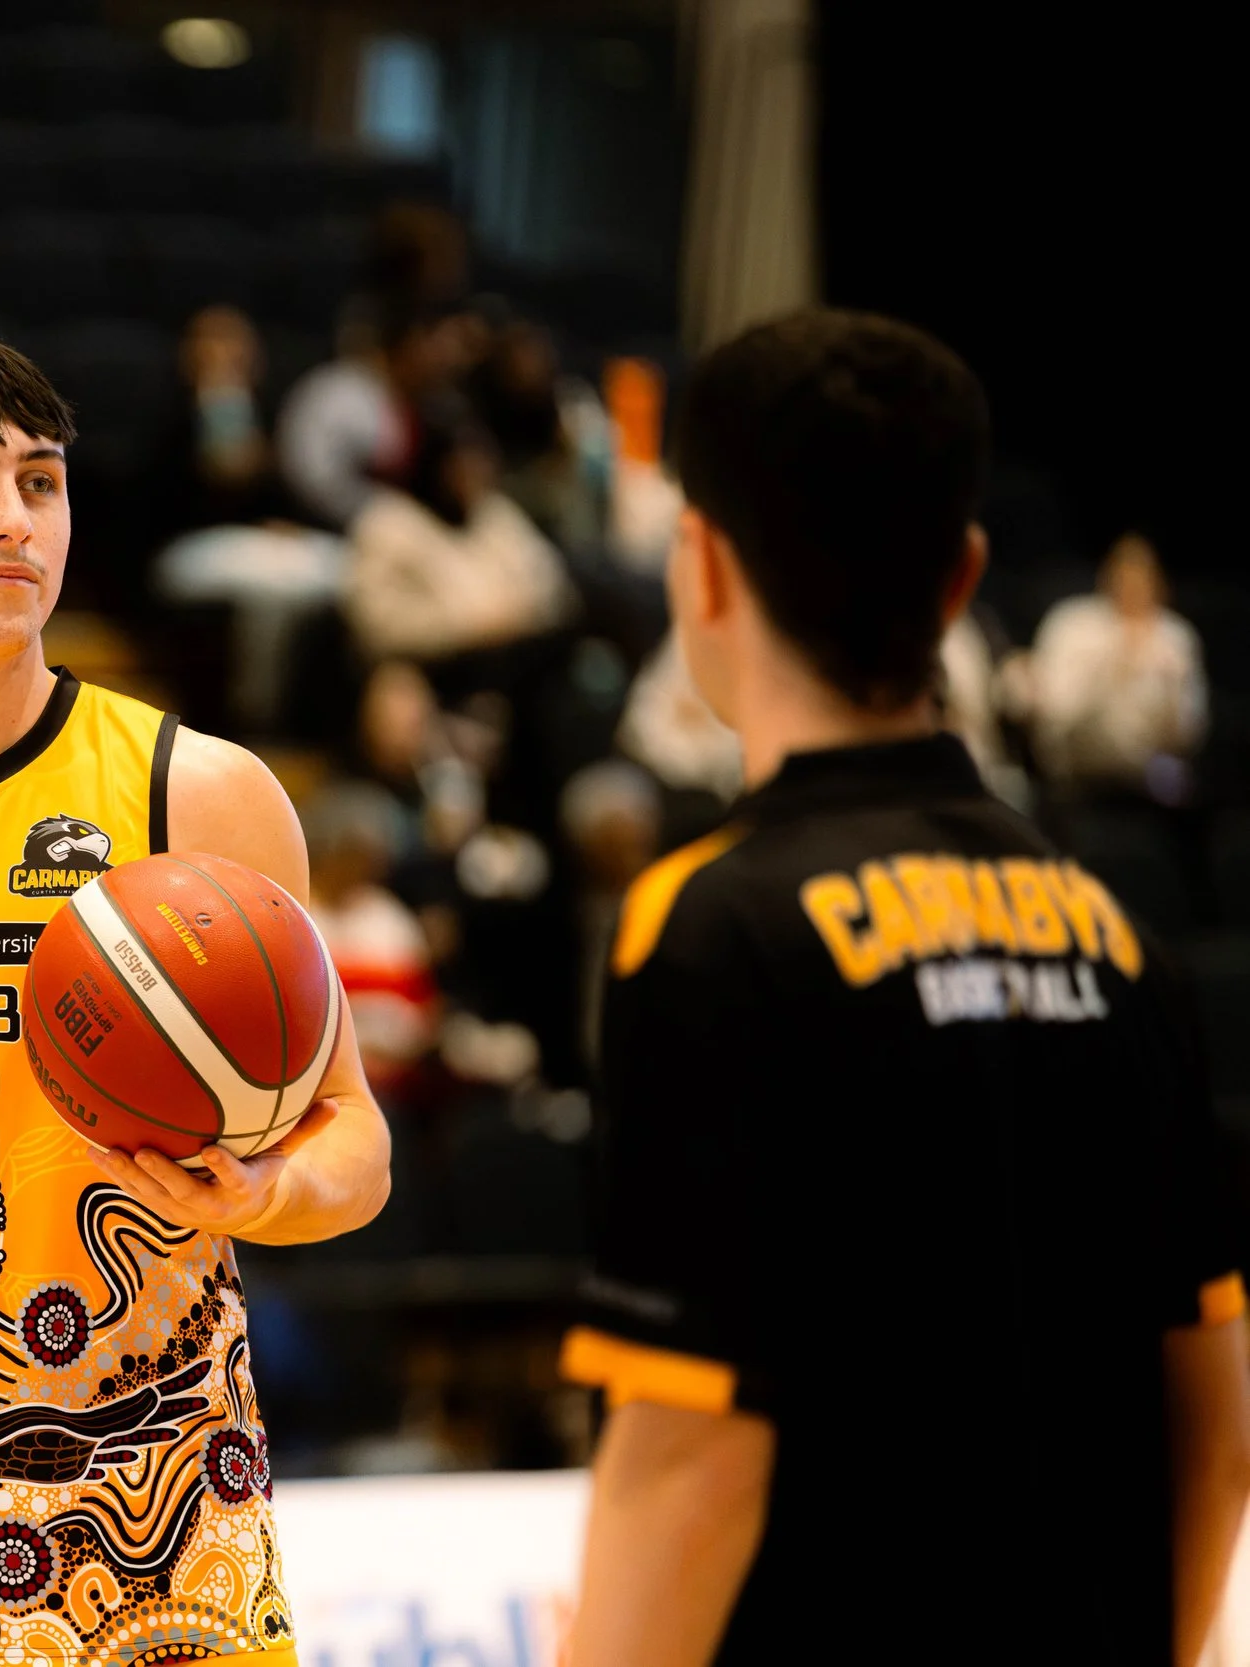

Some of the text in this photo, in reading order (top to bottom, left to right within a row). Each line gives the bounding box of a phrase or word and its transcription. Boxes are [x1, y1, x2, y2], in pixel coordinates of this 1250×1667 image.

[12, 868, 107, 891] CARNAB
[113, 939, 158, 993] BG4550
[54, 990, 105, 1058] FIBA
[72, 978, 116, 1034] APPROVED
